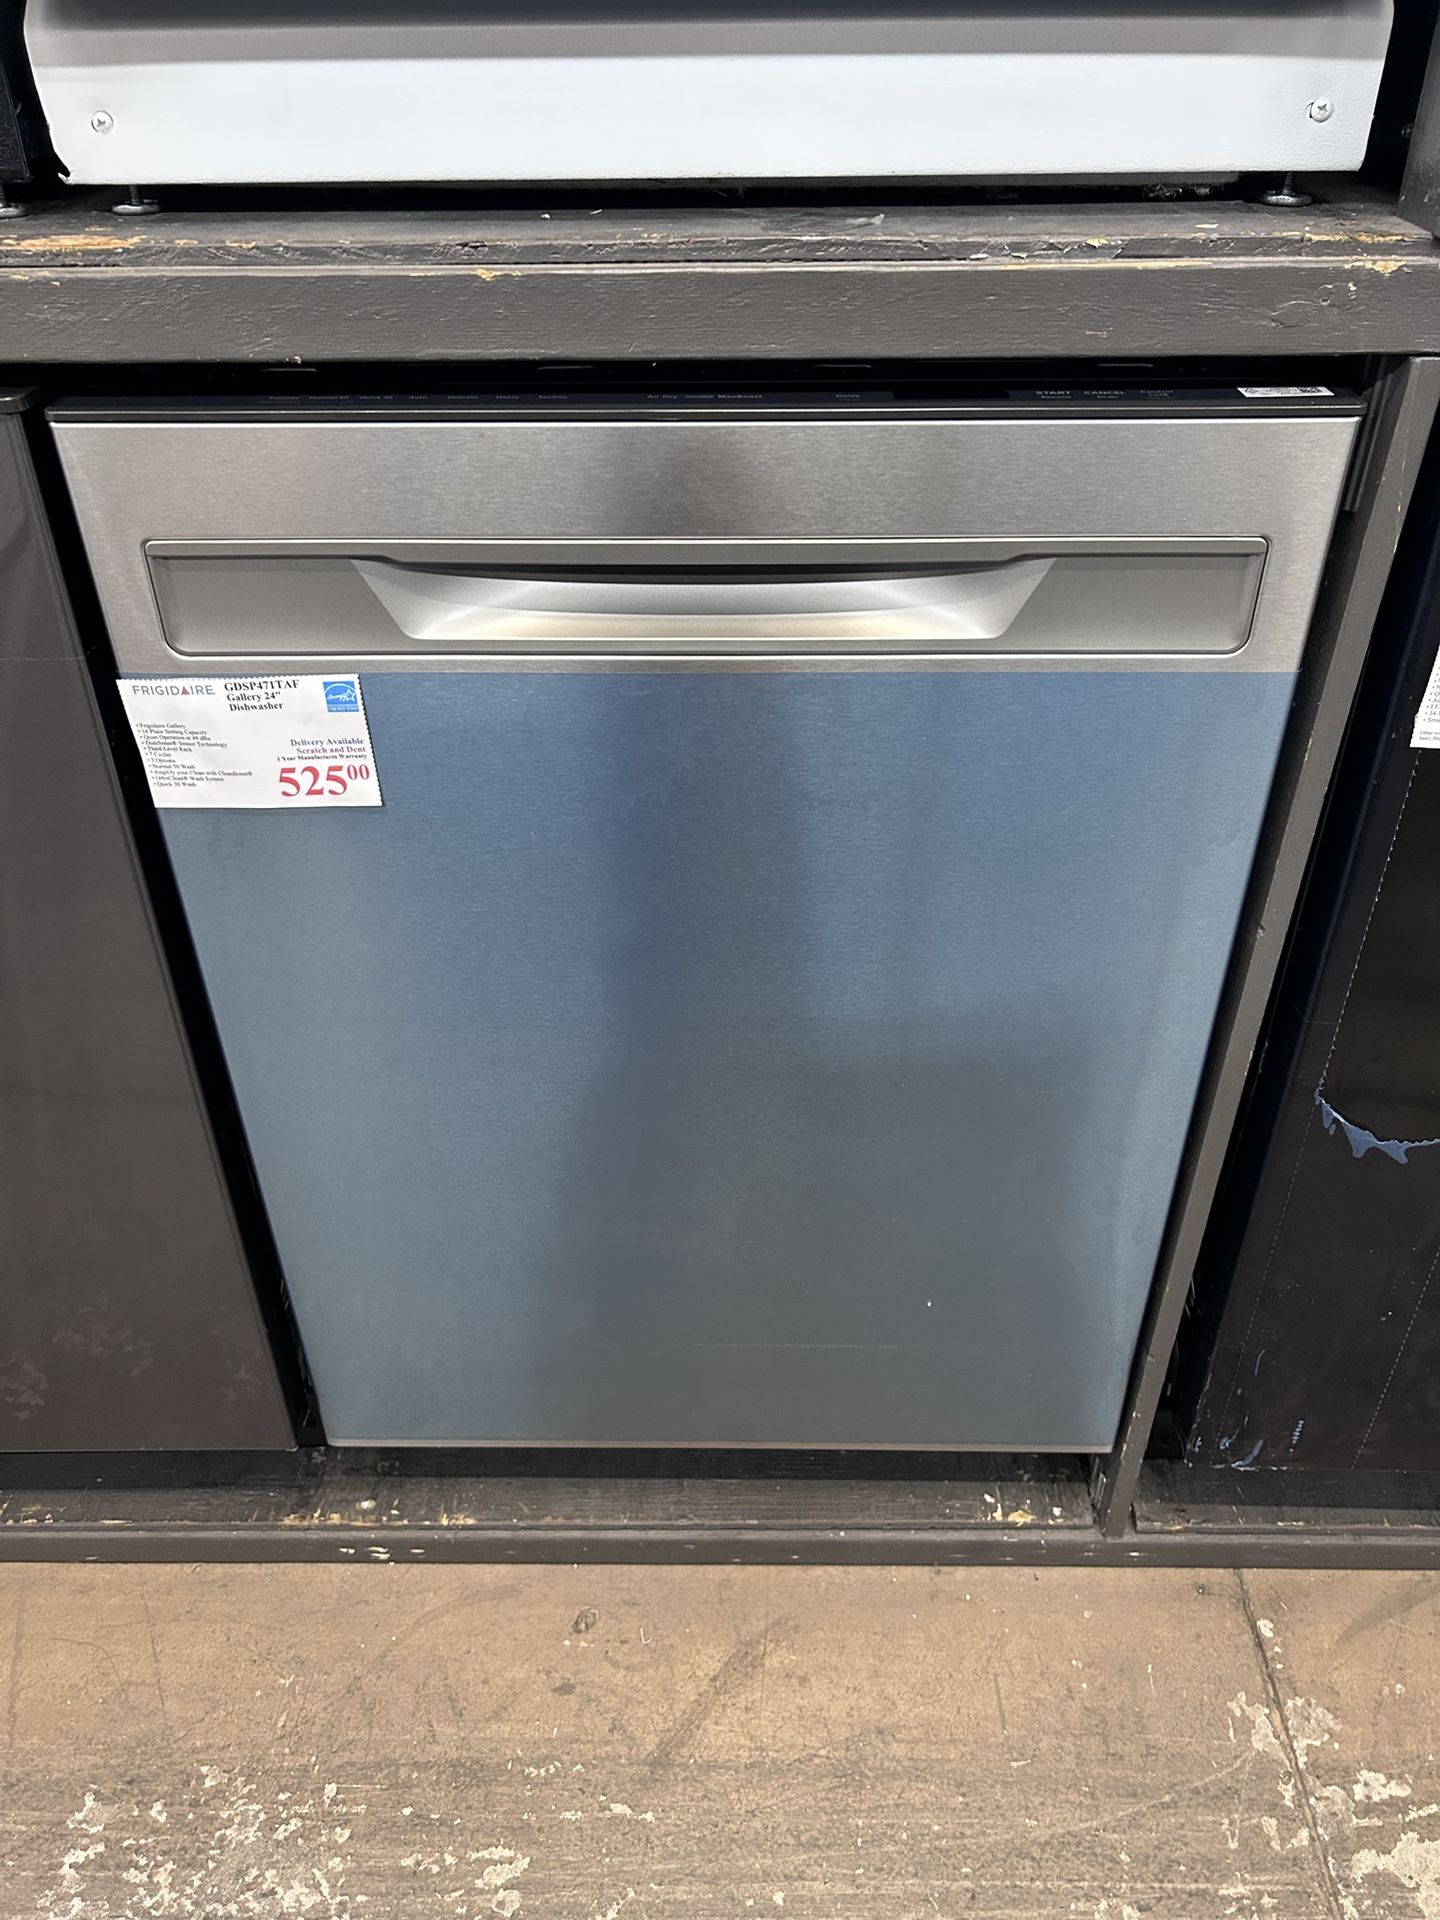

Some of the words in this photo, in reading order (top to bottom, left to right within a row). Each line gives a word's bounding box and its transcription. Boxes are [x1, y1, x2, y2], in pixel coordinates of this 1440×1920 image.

[132, 685, 215, 696] FRIGIDAIRE
[227, 692, 262, 702] Gallery
[264, 691, 281, 700] 24"
[229, 702, 284, 712] Dishwasher
[290, 738, 324, 747] Delivery
[326, 737, 364, 745] Available
